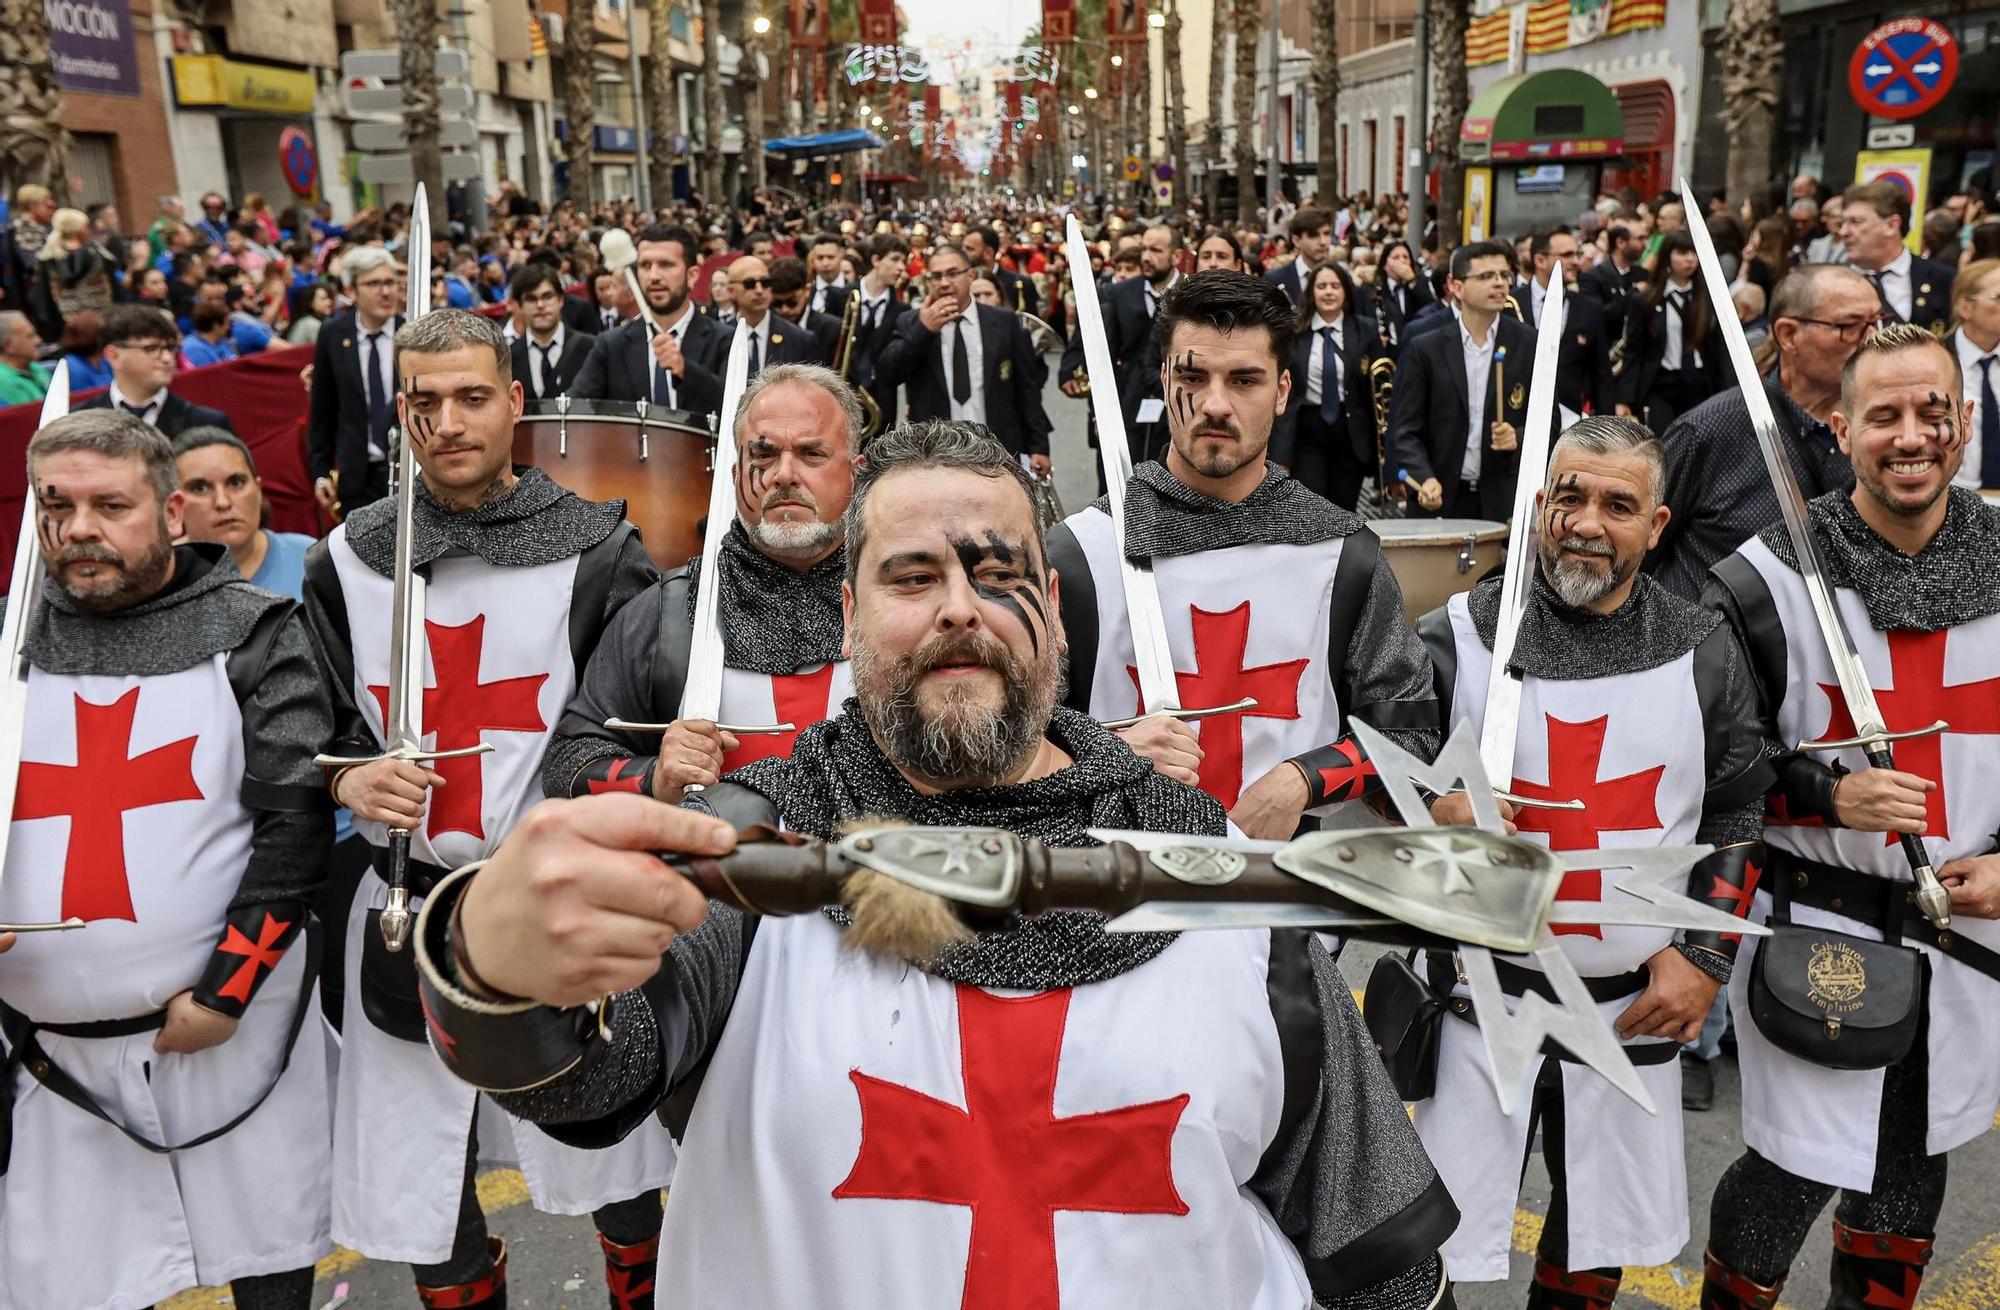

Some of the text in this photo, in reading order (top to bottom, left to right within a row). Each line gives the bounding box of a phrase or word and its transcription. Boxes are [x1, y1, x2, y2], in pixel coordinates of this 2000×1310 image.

[1864, 18, 1950, 50] EXCEPTO BUS
[1811, 941, 1866, 963] Caballeros
[1807, 987, 1864, 1013] Templarios
